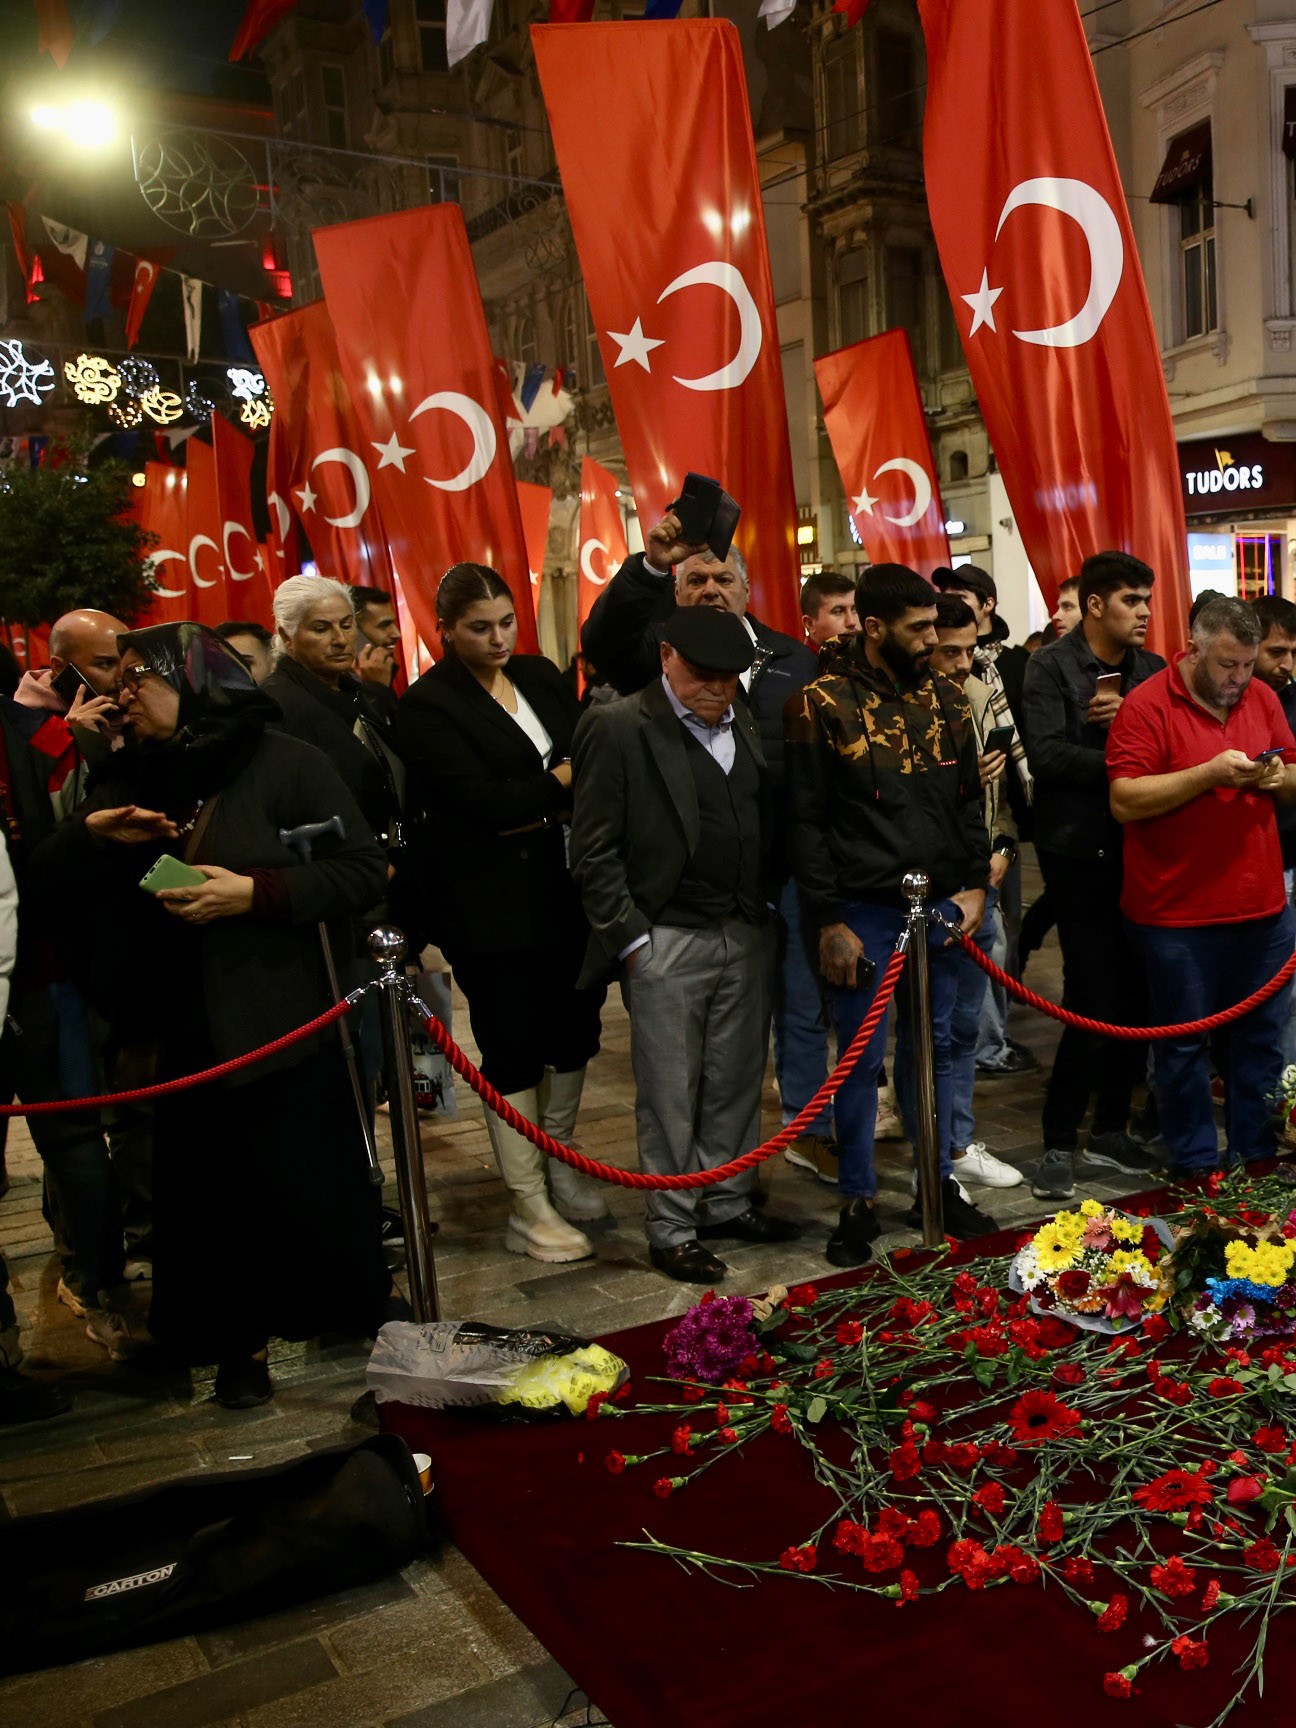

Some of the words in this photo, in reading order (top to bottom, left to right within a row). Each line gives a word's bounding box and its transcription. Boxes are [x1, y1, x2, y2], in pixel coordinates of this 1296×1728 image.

[1155, 155, 1201, 189] TUDORS
[1185, 465, 1264, 495] TUDORS
[93, 1563, 176, 1596] CARTON
